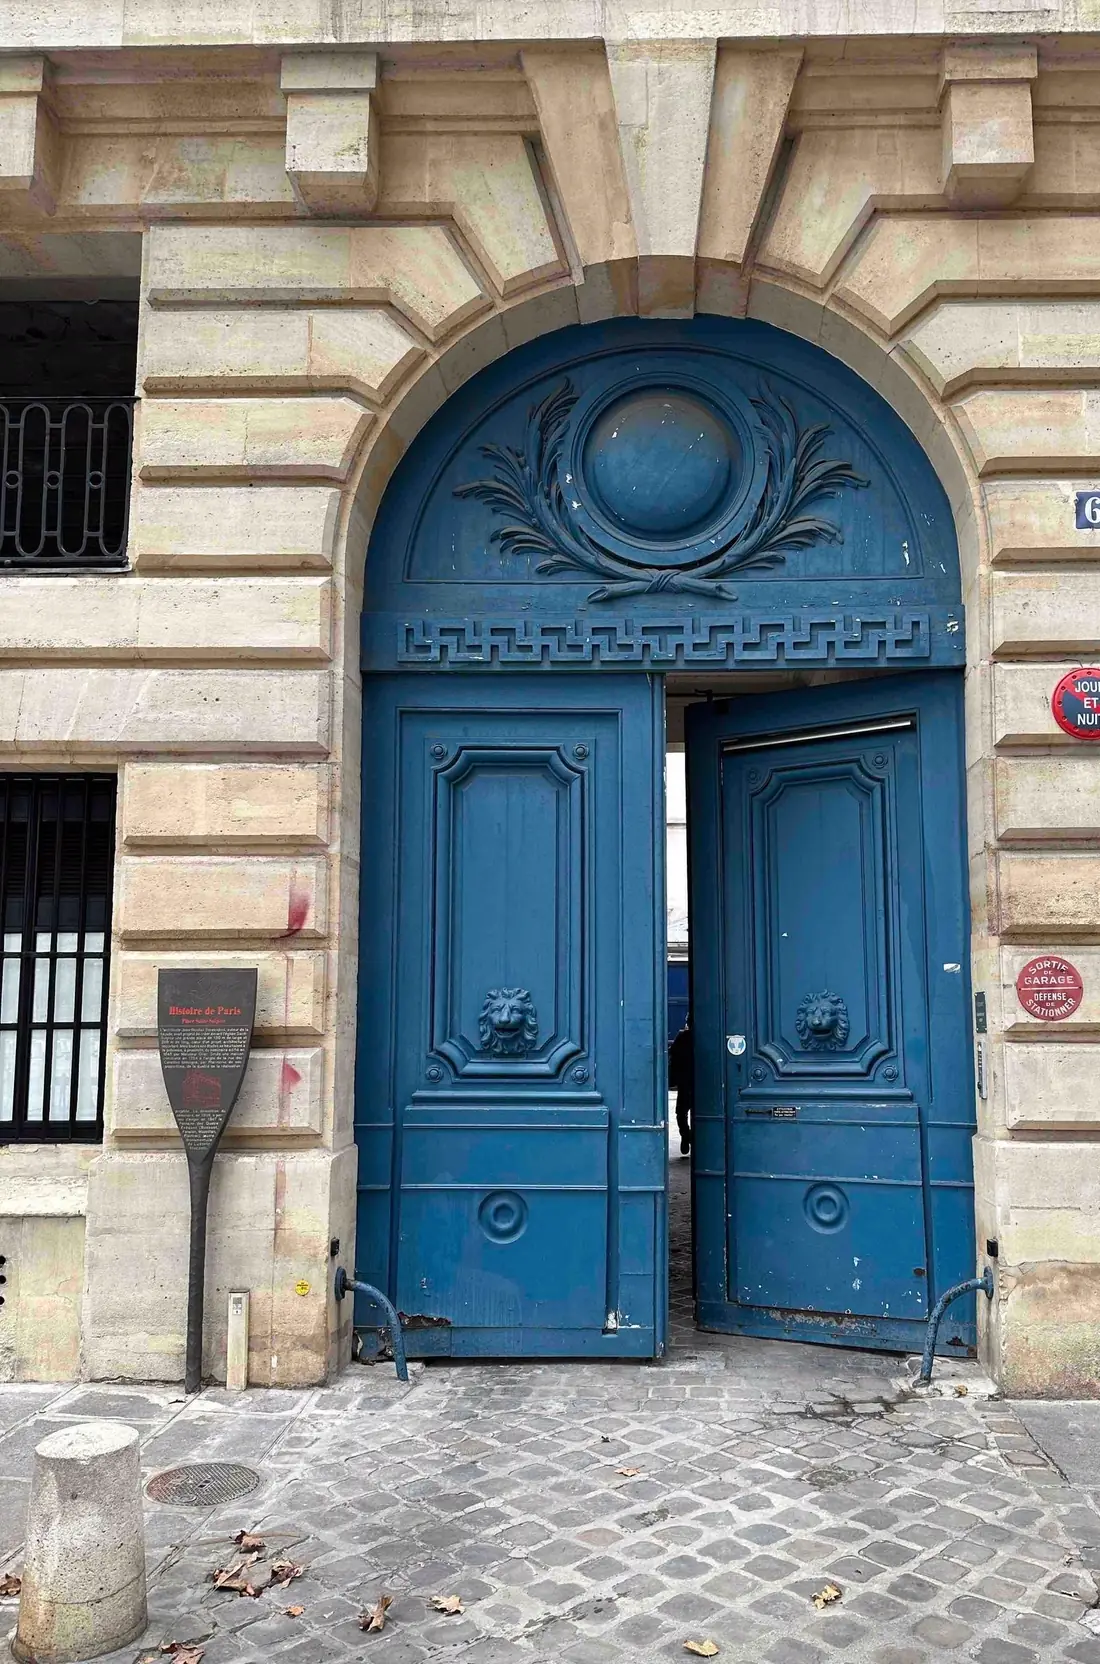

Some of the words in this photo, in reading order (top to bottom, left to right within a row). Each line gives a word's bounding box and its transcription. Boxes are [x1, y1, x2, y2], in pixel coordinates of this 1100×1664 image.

[1075, 681, 1100, 693] JOU
[1083, 697, 1099, 709] ET
[1029, 960, 1069, 975] SORTIE
[1024, 975, 1075, 985] GARAGE
[169, 1006, 203, 1015] Histoire
[204, 1006, 215, 1015] de
[217, 1006, 241, 1015] Paris
[1026, 998, 1076, 1017] STATIONNER
